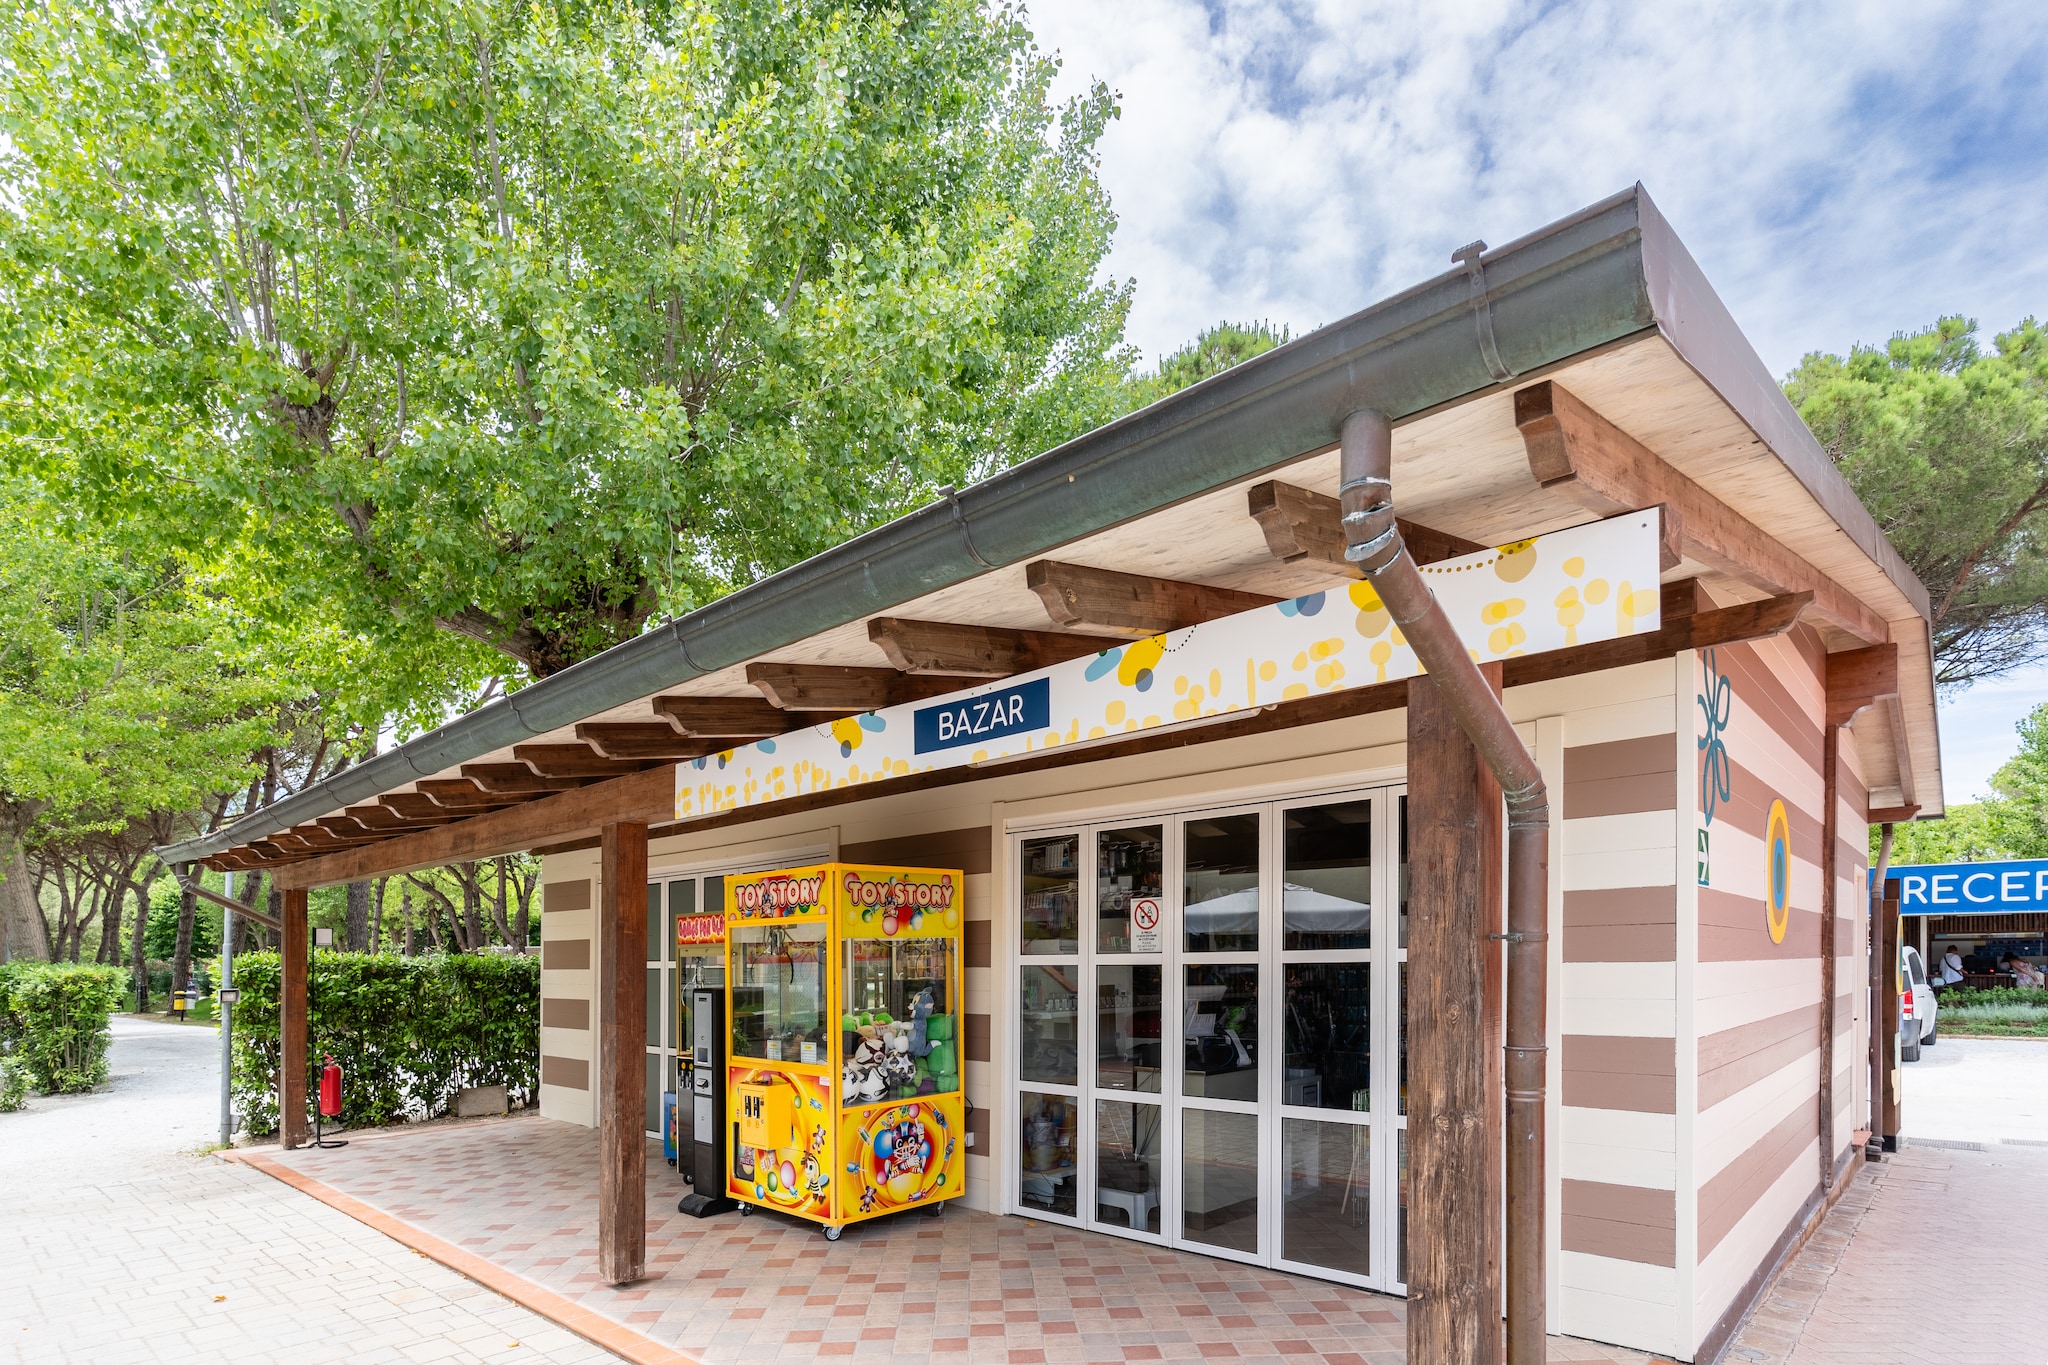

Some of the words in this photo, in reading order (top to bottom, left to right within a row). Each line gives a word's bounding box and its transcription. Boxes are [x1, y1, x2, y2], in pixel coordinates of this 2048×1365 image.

[939, 694, 1024, 741] BAZAR
[736, 883, 766, 911] TOY
[769, 877, 821, 907] STORY
[849, 881, 889, 907] TOY
[892, 882, 954, 908] STORY
